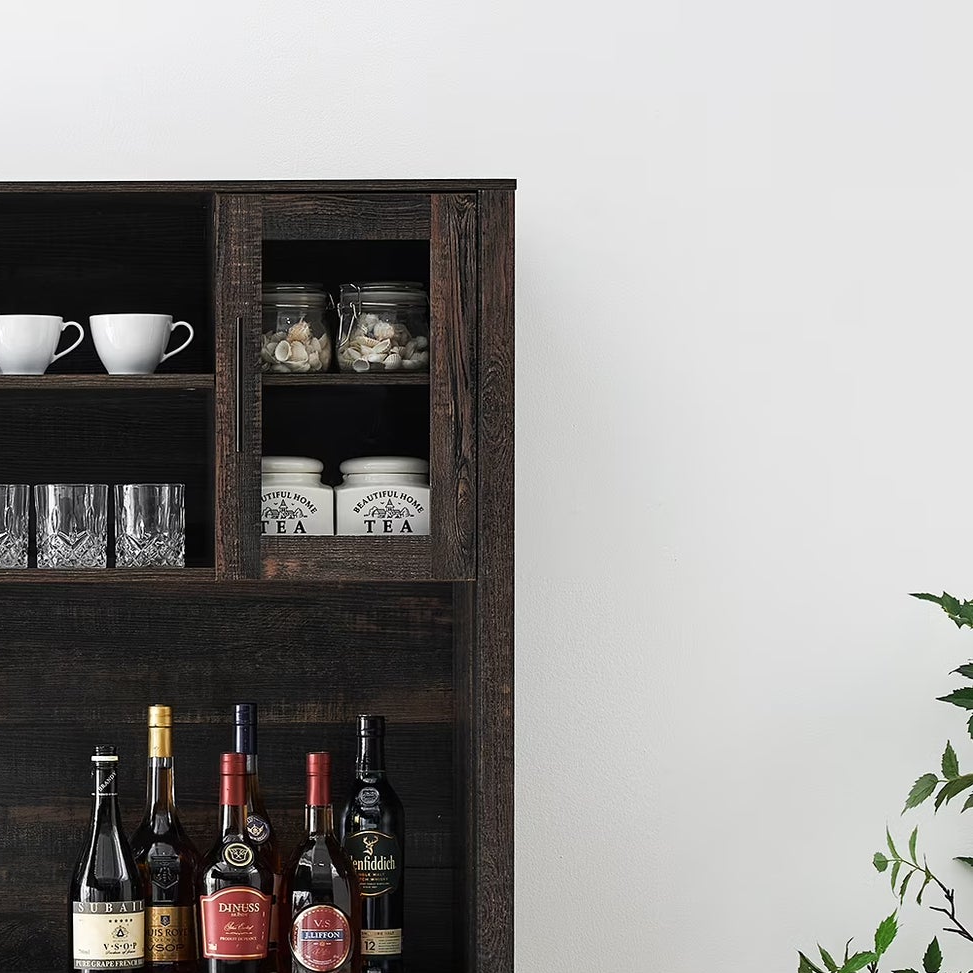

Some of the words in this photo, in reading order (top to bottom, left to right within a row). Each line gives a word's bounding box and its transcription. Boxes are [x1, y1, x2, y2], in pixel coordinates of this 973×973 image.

[261, 491, 293, 503] UTIFUL
[294, 493, 318, 514] HOME
[353, 490, 399, 514] BEAUTIFUL
[400, 492, 425, 514] HOME
[363, 519, 413, 533] TEA
[350, 854, 397, 871] enfiddich
[146, 943, 185, 952] VSOP
[364, 940, 376, 951] 12
